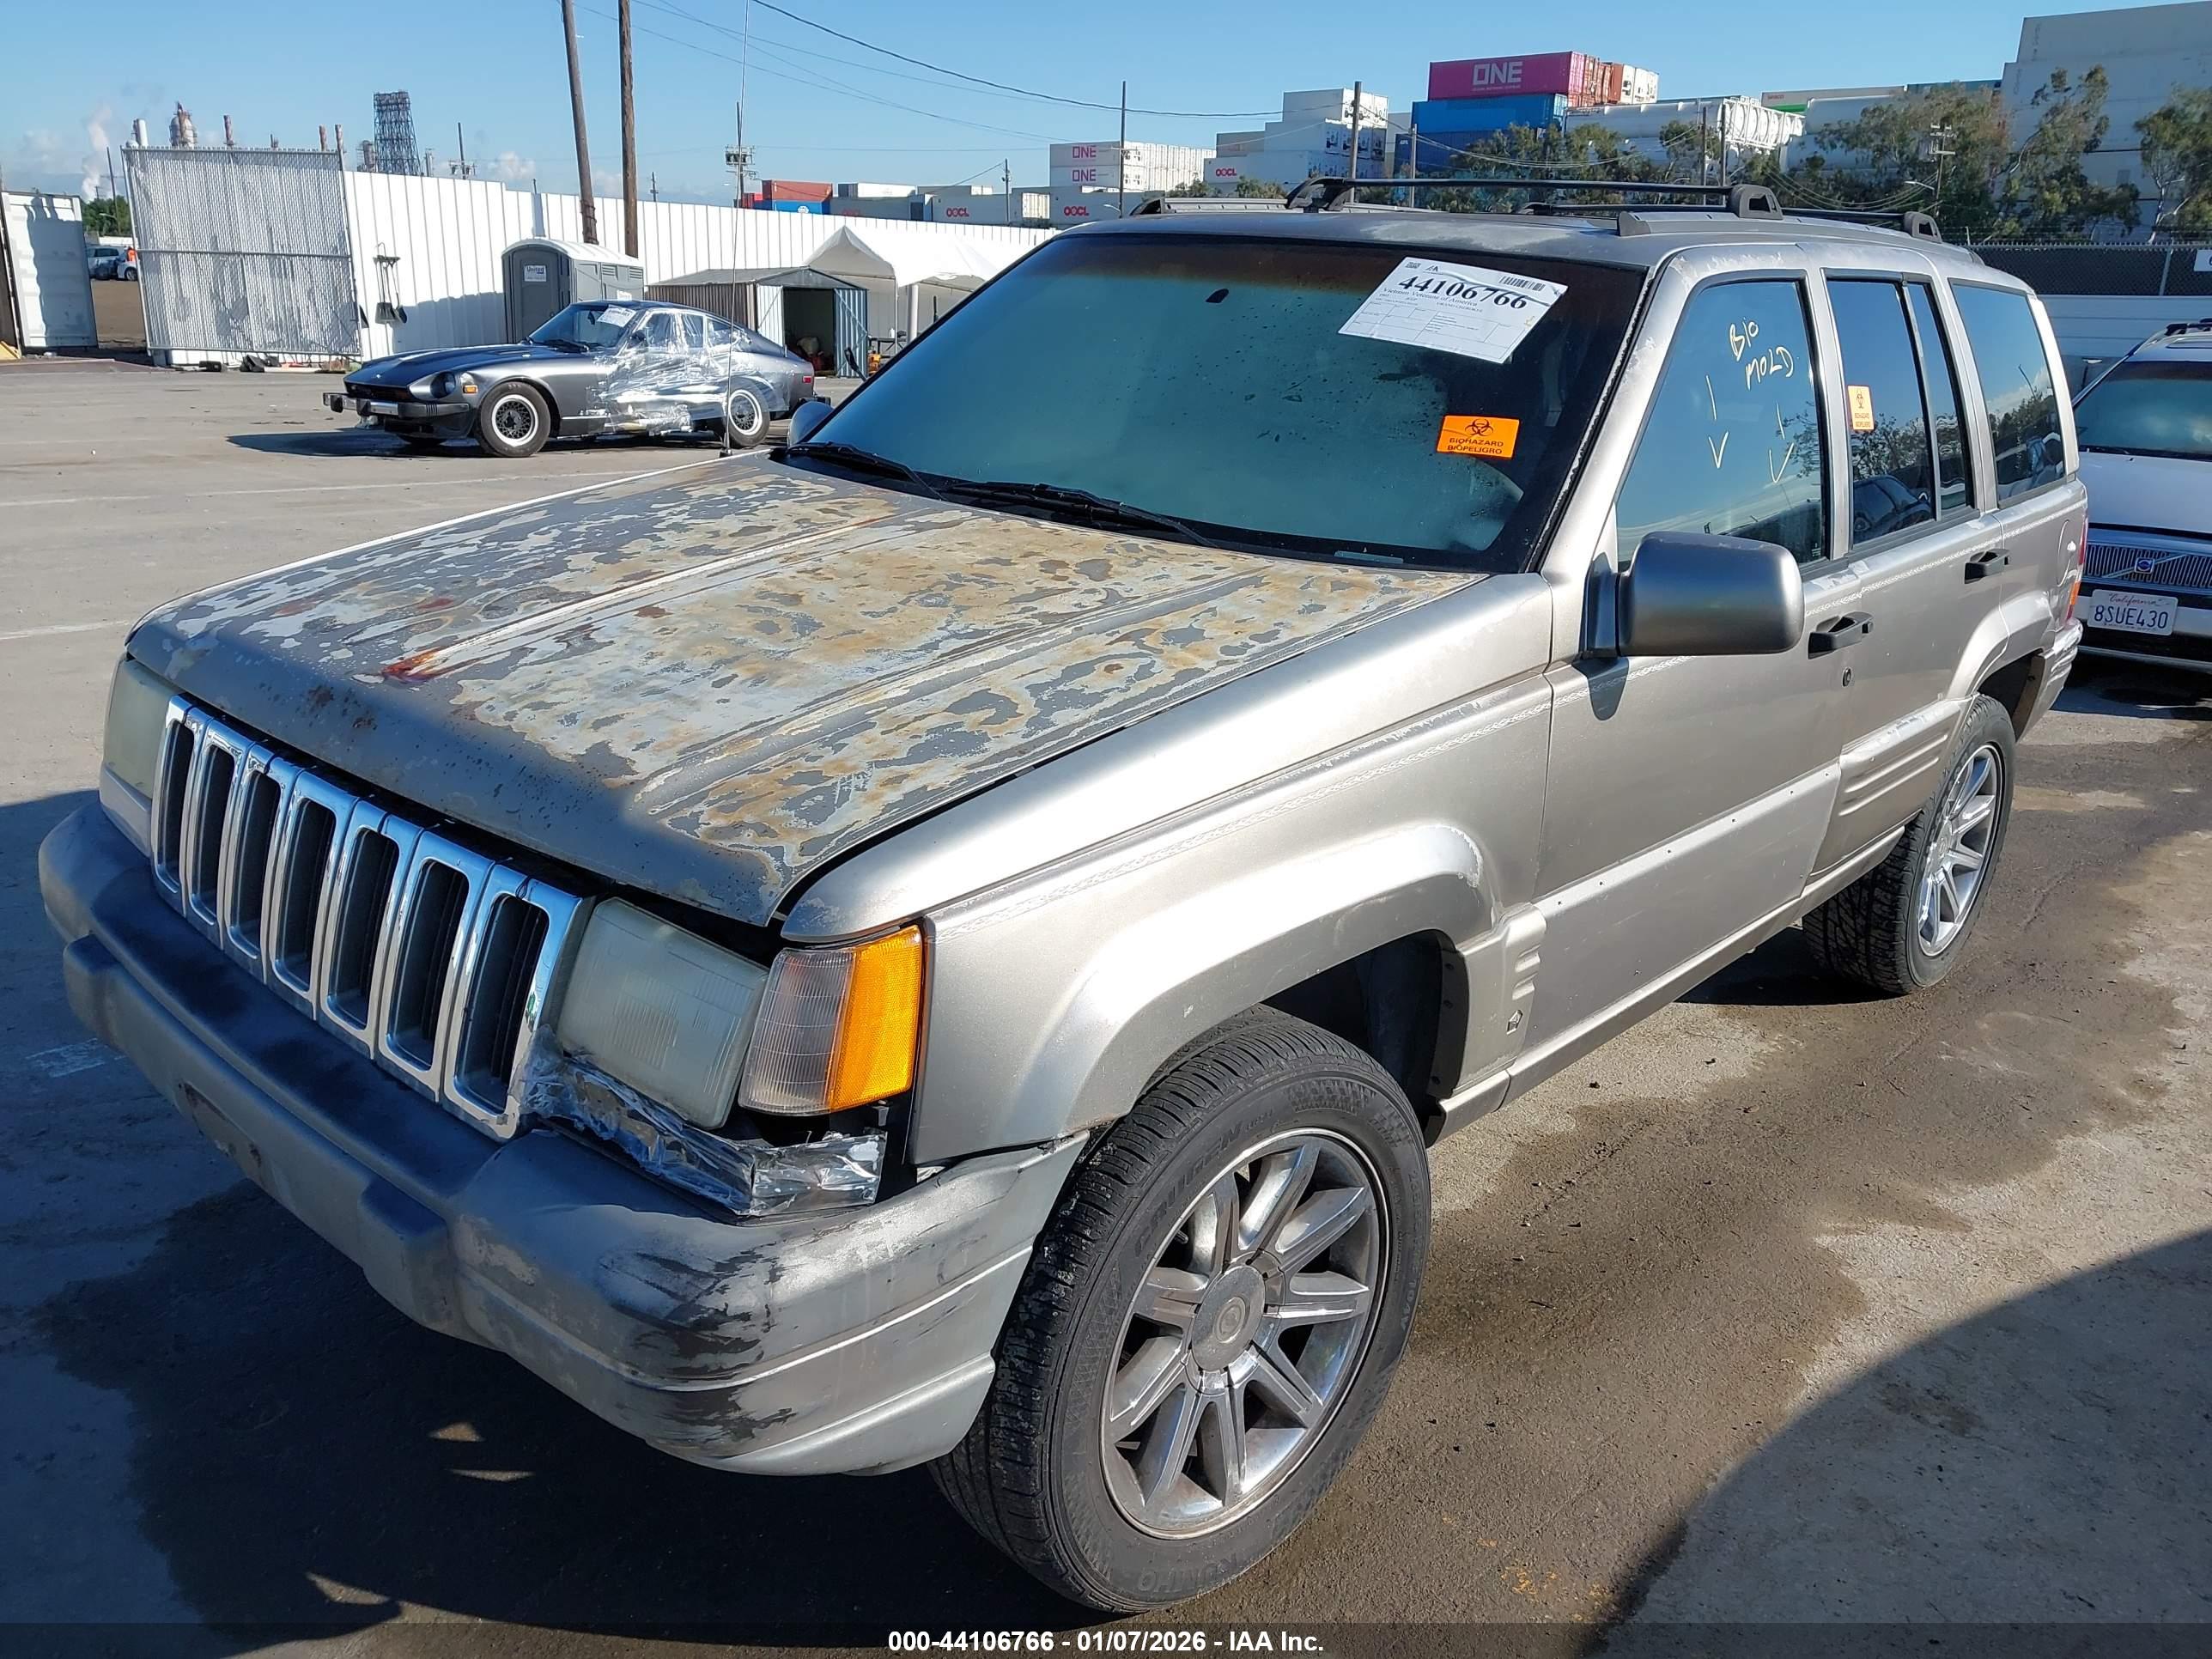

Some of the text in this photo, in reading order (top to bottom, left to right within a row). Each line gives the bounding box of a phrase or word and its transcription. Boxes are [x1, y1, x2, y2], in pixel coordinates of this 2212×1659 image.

[1473, 62, 1522, 85] ONE
[1073, 145, 1097, 158] ONE
[1073, 169, 1097, 182] ONE
[1216, 168, 1237, 177] OOCL
[946, 207, 969, 217] OOCL
[1063, 206, 1090, 216] OOCL
[1398, 276, 1527, 310] 44106766
[1746, 346, 1794, 391] MOLD
[1449, 437, 1504, 447] BIOHAZARD
[1447, 445, 1503, 454] BIOPELIGRO
[2109, 592, 2158, 606] California
[2094, 605, 2169, 629] 8SUE430
